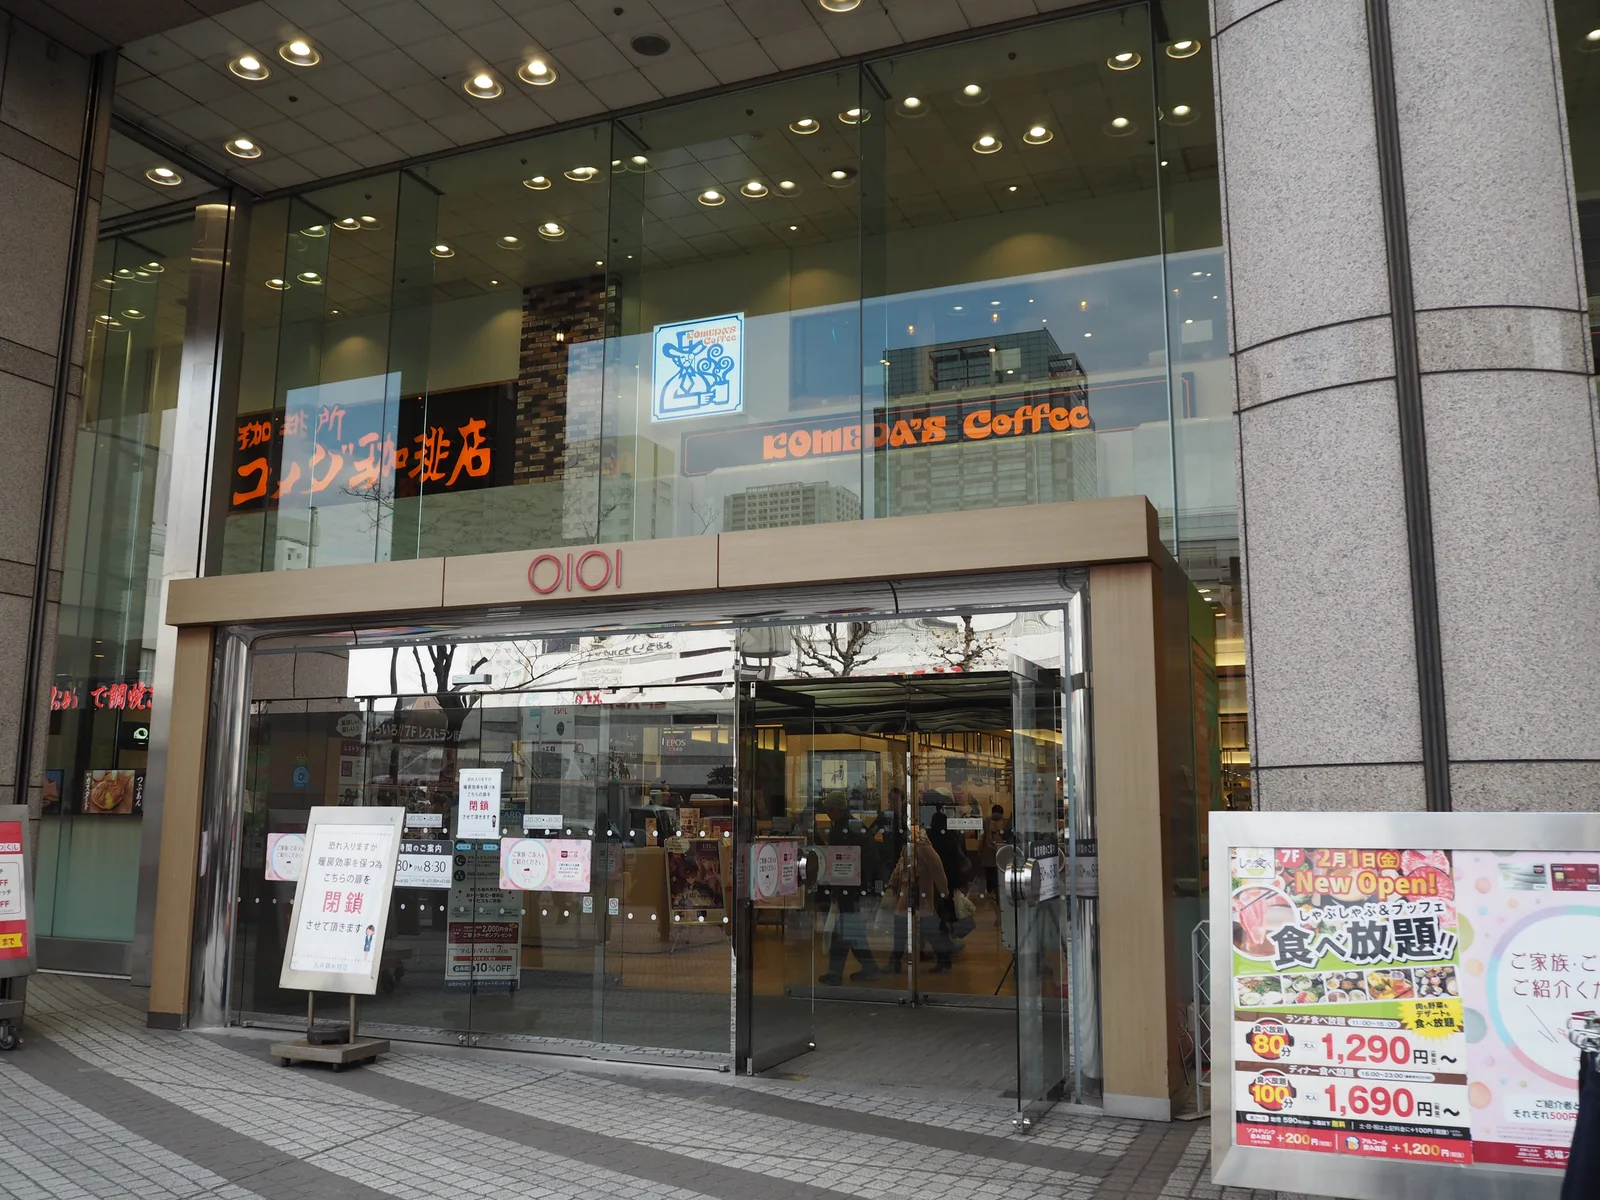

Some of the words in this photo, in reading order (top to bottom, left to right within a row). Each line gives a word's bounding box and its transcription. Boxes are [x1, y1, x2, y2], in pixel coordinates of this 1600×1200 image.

[687, 325, 737, 340] KOMEDA'S
[703, 335, 737, 345] Coffee
[763, 415, 947, 460] KOMEDA'S
[963, 403, 1091, 439] Coffee
[405, 725, 418, 737] 7F
[666, 738, 686, 747] EPOS
[135, 776, 144, 807] つぶあん
[469, 800, 489, 811] 閉鎖
[328, 841, 378, 851] 恐れ入りますが
[1281, 849, 1300, 863] 7F
[317, 857, 382, 869] 暖房効率を保つ為
[423, 860, 447, 873] 8:30
[323, 873, 371, 884] こちらの扉を
[1295, 872, 1351, 894] New
[1358, 872, 1437, 899] Open!
[322, 890, 364, 914] 閉鎖
[1300, 902, 1444, 922] しゃぶしゃぶ&ブッフェ
[306, 920, 363, 933] させて頂きます
[1415, 1001, 1449, 1010] 肉も野菜も
[1416, 1009, 1451, 1018] デザートも
[1285, 1014, 1346, 1026] ランチ食べ放題
[1415, 1017, 1456, 1029] 食べ放題
[1254, 1025, 1285, 1034] 食べ放題
[1256, 1077, 1287, 1085] 食べ放題
